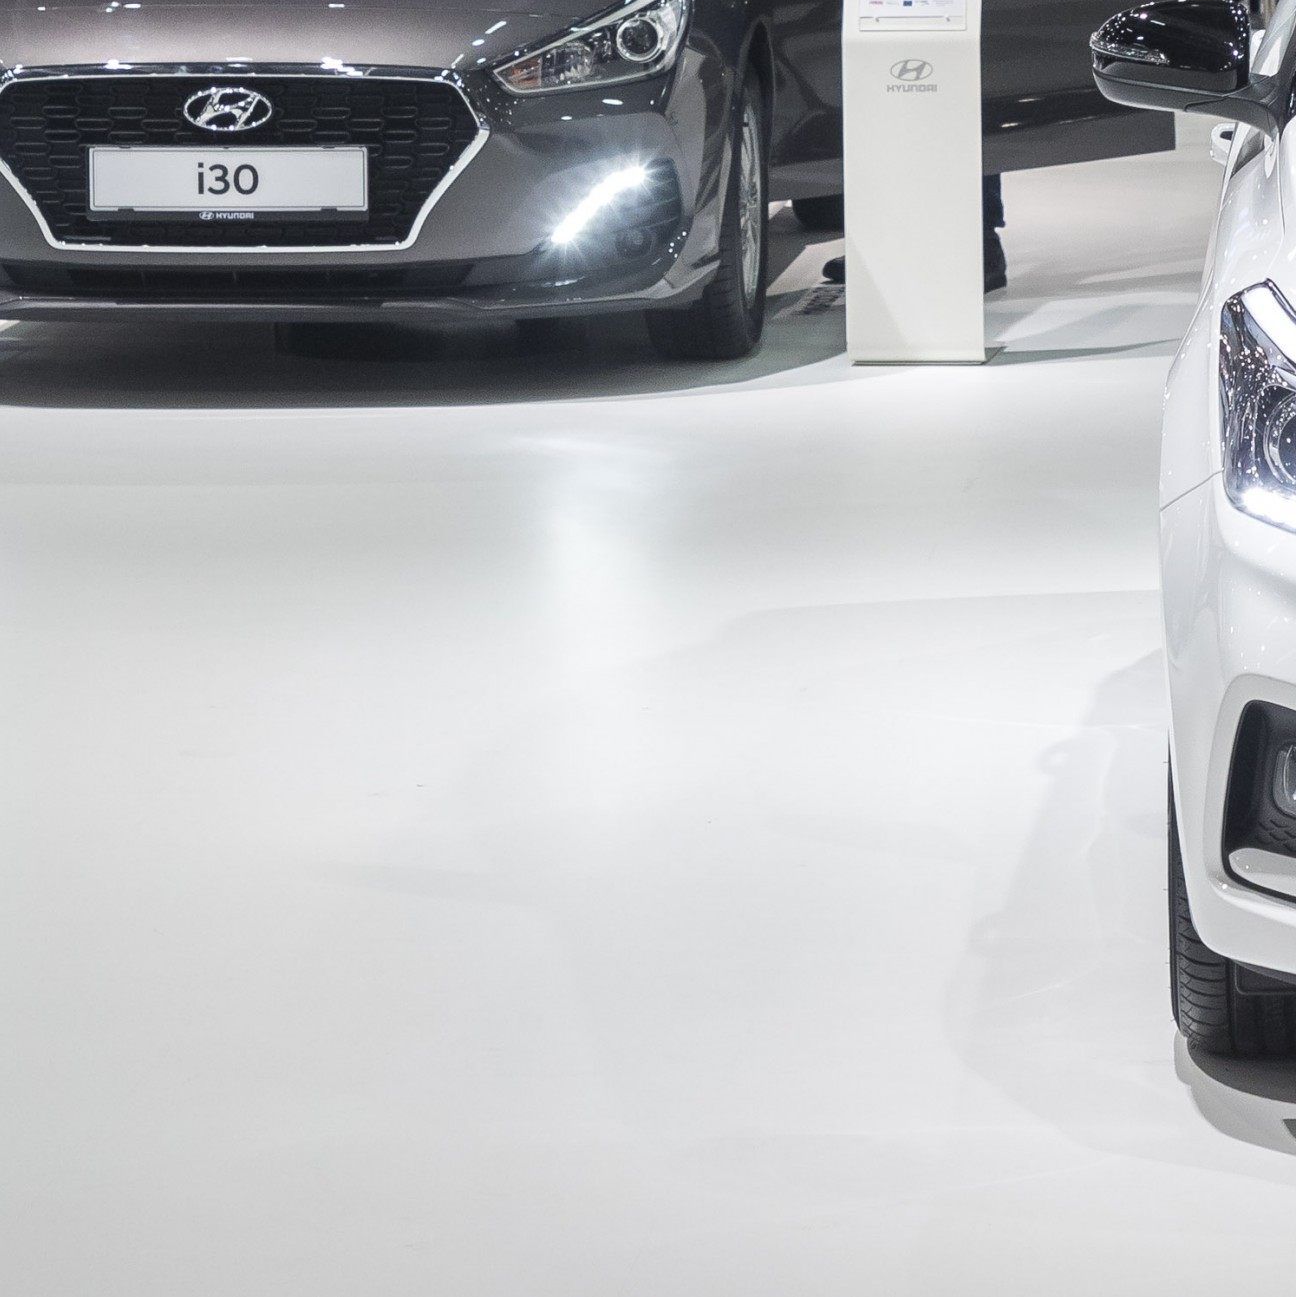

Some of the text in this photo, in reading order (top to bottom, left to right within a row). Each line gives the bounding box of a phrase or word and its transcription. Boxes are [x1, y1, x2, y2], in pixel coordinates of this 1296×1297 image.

[886, 84, 938, 93] HYUNDAI
[197, 162, 259, 195] i30
[215, 211, 254, 219] HYUNDAI
